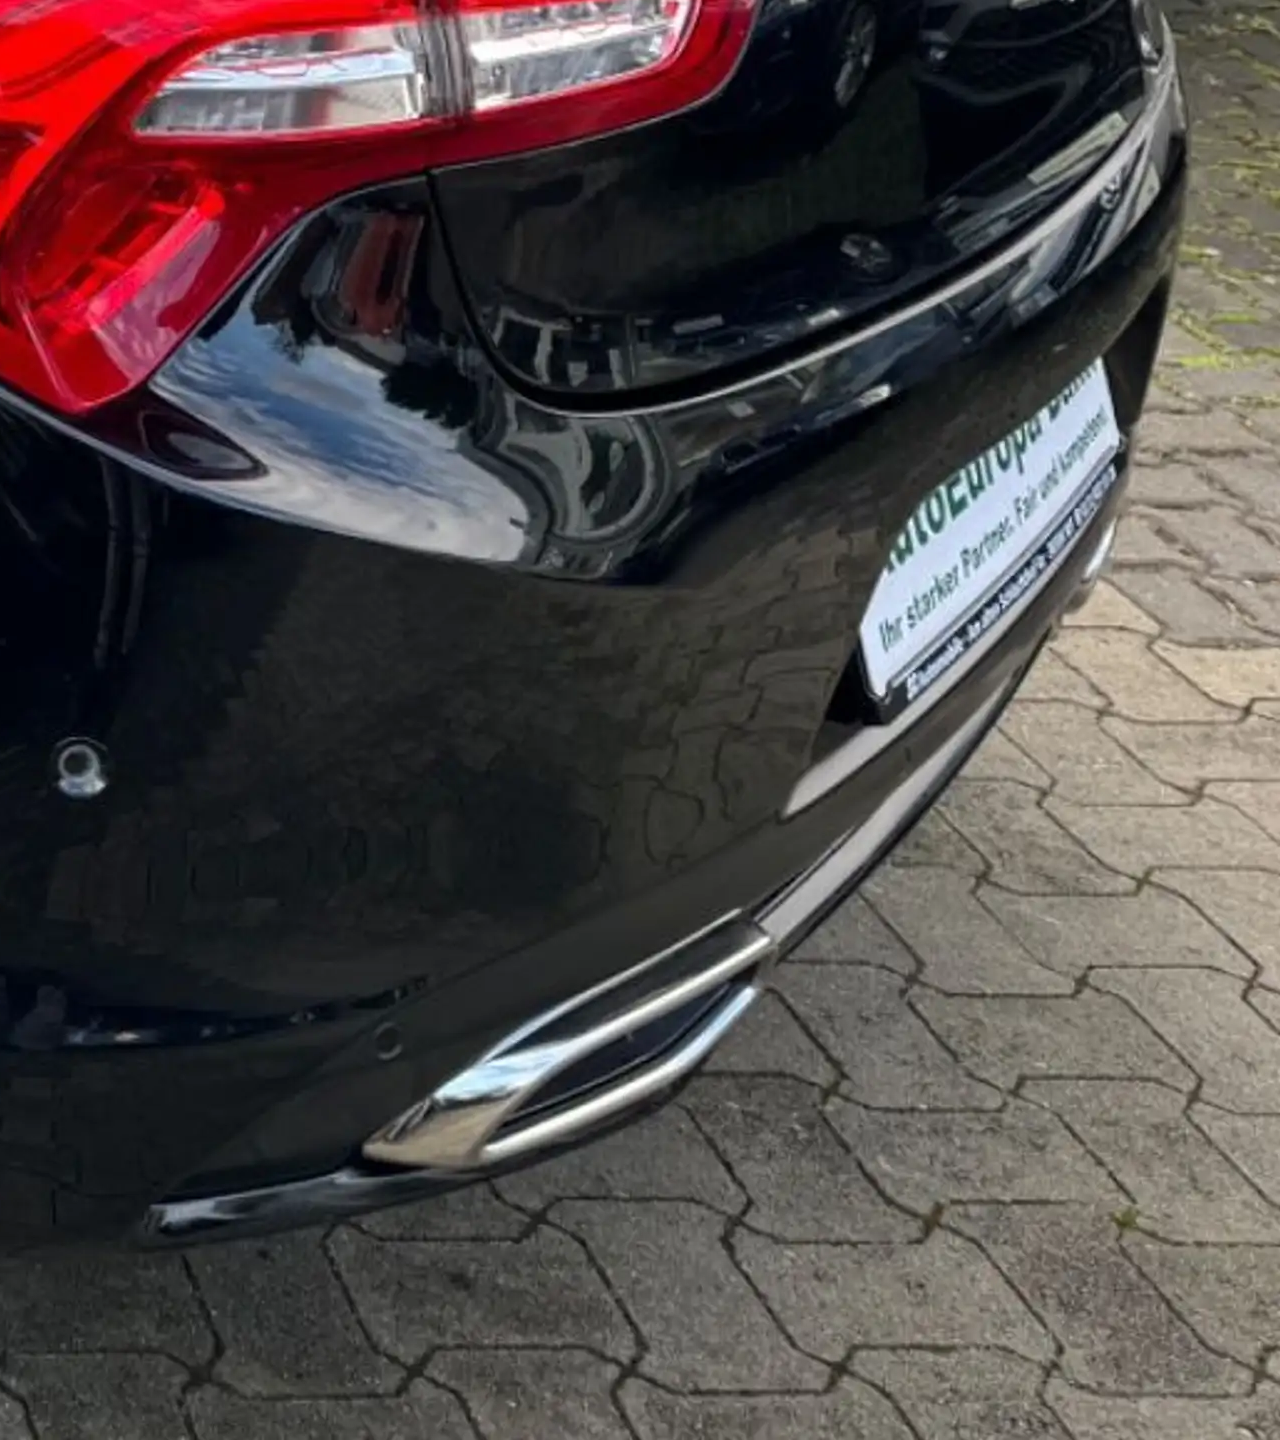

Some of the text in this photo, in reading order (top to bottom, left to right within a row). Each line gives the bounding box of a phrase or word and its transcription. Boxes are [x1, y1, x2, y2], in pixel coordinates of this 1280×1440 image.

[879, 616, 904, 652] Ihr
[906, 564, 959, 629] starker
[1014, 485, 1038, 526] Fair
[1039, 457, 1060, 501] und
